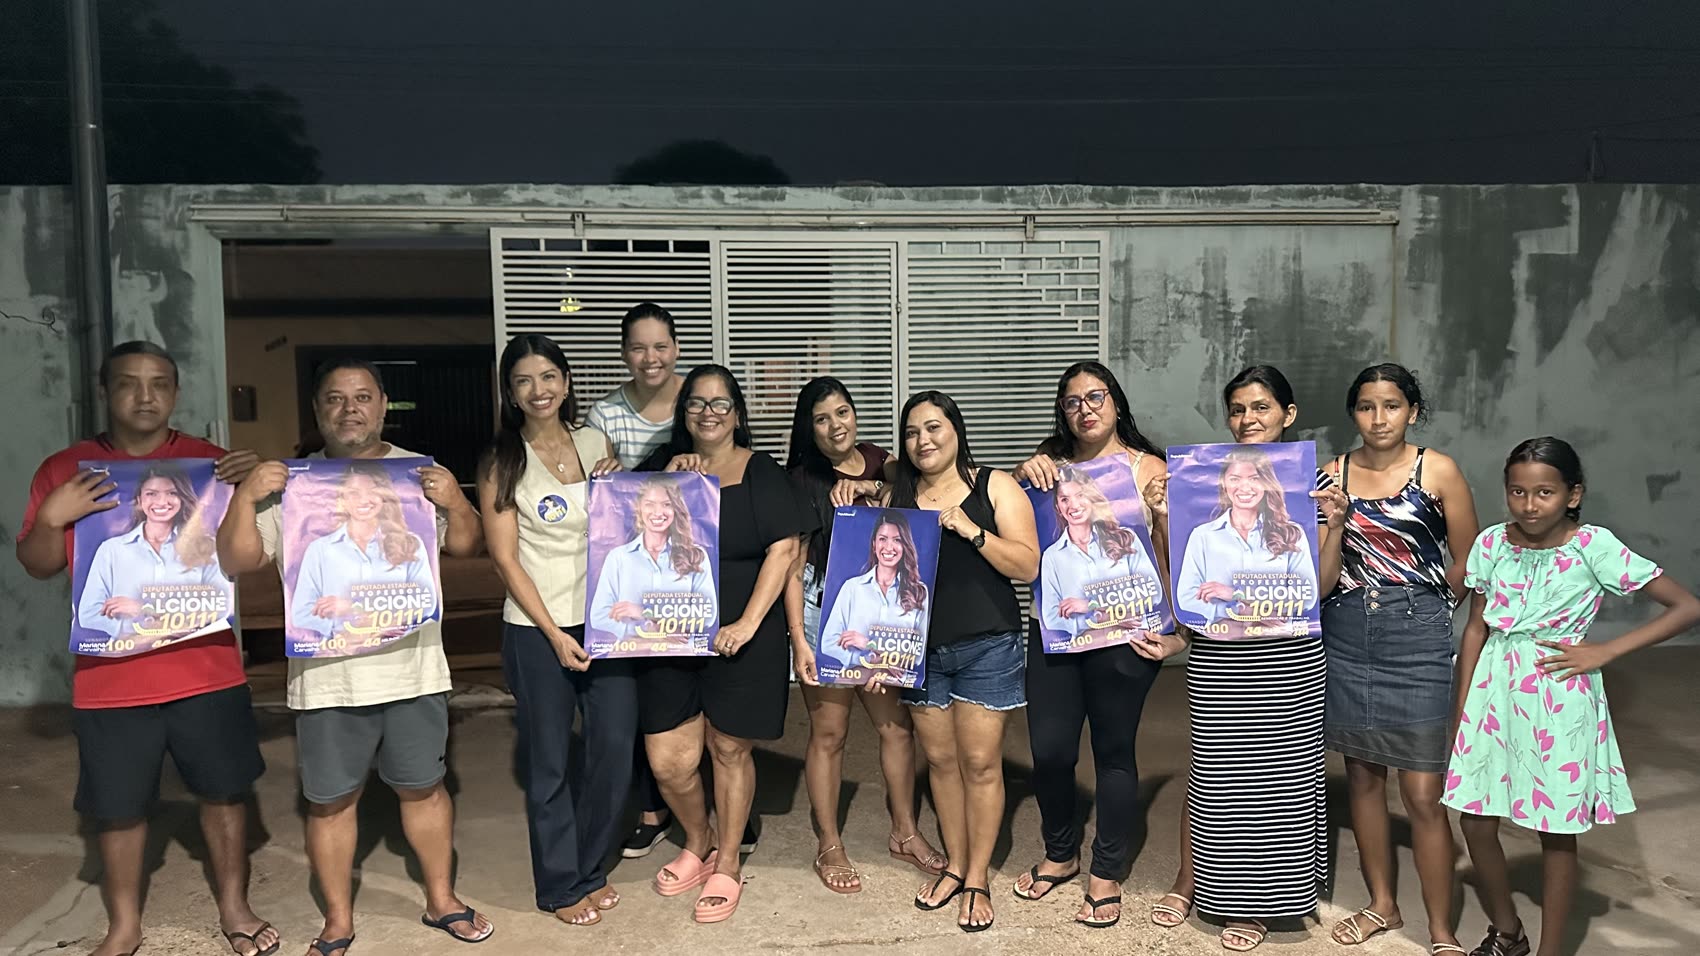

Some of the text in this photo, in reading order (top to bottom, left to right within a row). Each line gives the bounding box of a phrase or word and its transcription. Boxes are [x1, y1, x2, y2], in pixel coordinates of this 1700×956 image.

[1084, 574, 1144, 590] DEPUTADA ESTADUAL
[1084, 576, 1152, 596] PROFESSORA
[142, 585, 179, 593] DEPUTADA
[142, 590, 225, 599] PROFESSORA
[351, 588, 430, 598] PROFESSORA
[1106, 596, 1153, 622] 10111
[1250, 600, 1304, 616] 10111
[159, 611, 218, 630] 10111
[368, 608, 424, 628] 10111
[656, 618, 705, 634] 10111
[1206, 624, 1228, 634] 100
[869, 631, 924, 640] PROFESSORA
[1072, 634, 1092, 648] 100
[106, 639, 135, 652] 100
[320, 638, 346, 650] 100
[614, 642, 636, 652] 100
[880, 652, 916, 670] 10111
[840, 669, 862, 679] 100
